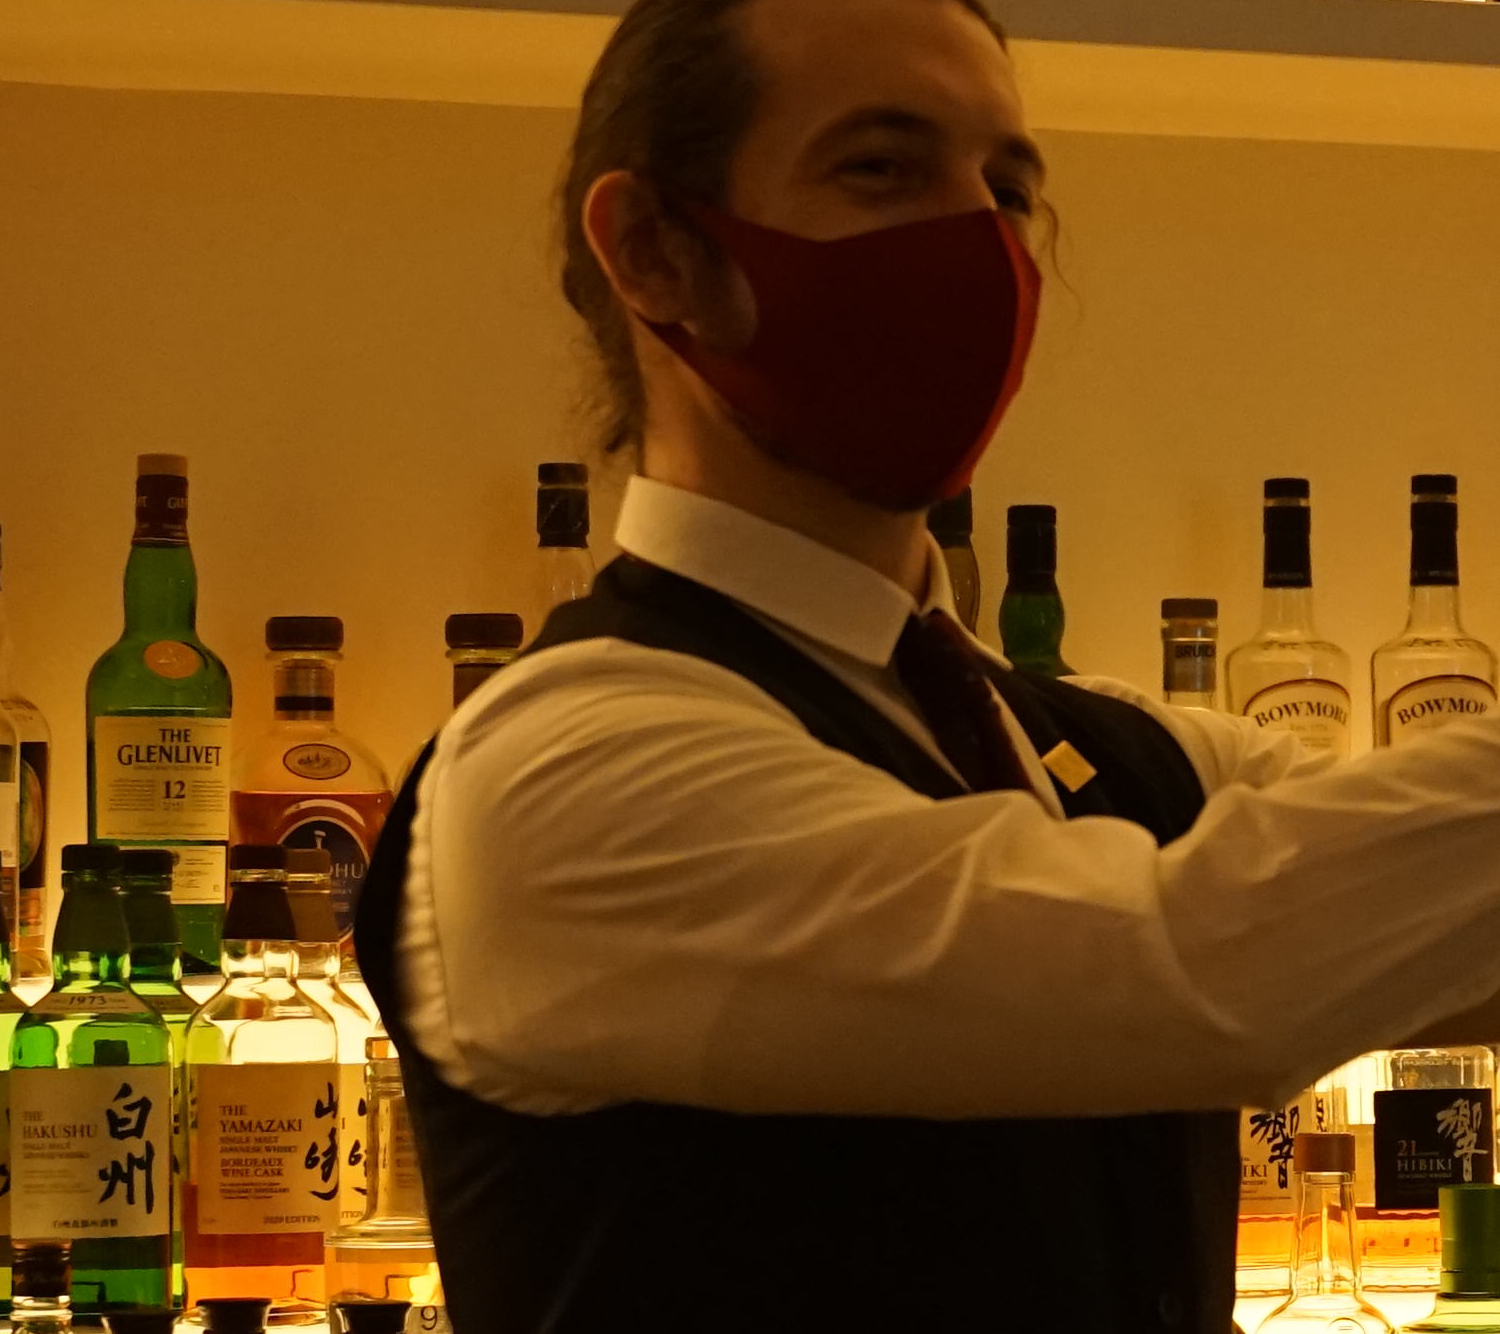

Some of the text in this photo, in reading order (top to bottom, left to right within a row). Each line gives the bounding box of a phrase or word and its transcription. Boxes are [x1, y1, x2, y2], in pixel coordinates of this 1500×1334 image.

[158, 727, 192, 743] THE
[117, 743, 223, 766] GLENLIVET
[162, 779, 186, 801] 12
[218, 1104, 248, 1118] THE
[21, 1123, 100, 1140] HAKUSHU
[219, 1118, 303, 1134] YAMAZAKI
[97, 1082, 157, 1215] 白州
[1396, 1139, 1417, 1156] 21
[1396, 1158, 1453, 1172] HIBIKI
[420, 1306, 439, 1331] 9
